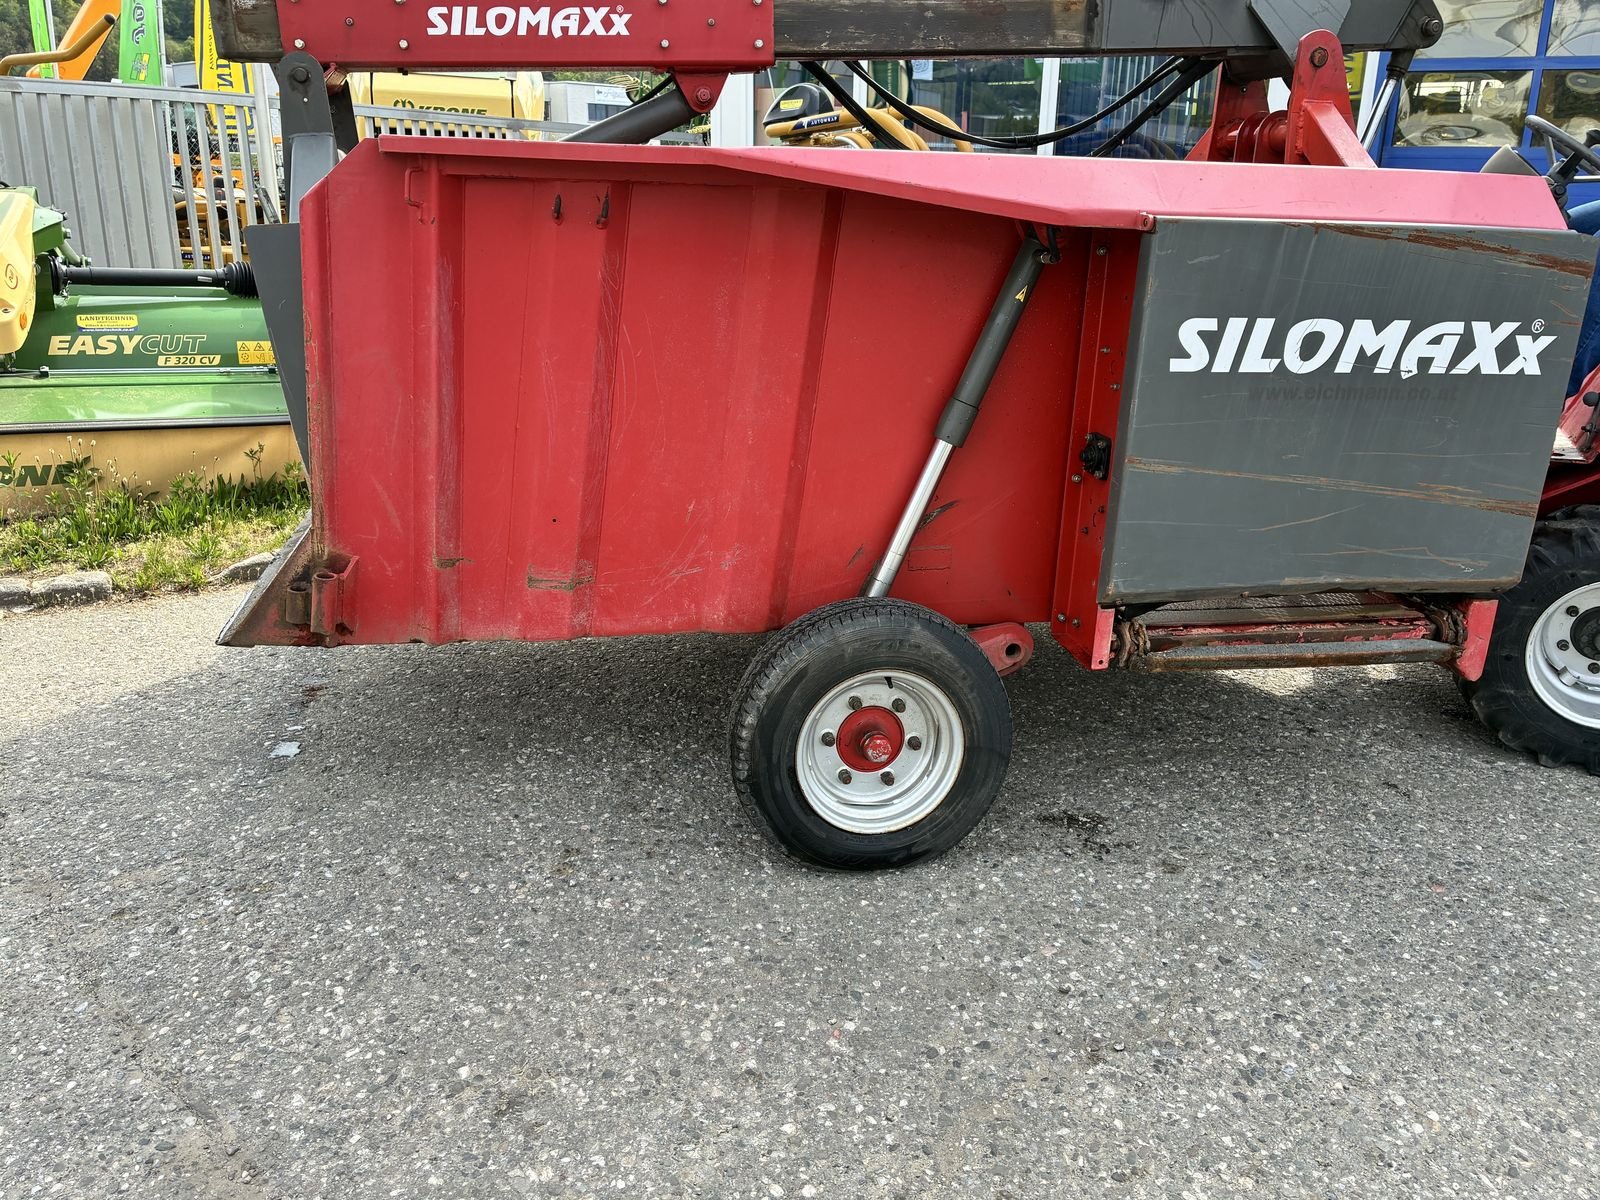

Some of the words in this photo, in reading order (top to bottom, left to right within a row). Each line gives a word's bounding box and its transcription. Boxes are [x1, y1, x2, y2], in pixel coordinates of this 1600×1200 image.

[48, 334, 208, 356] EASYCUT
[164, 356, 171, 365] F
[174, 356, 196, 365] 320
[200, 356, 216, 365] CV
